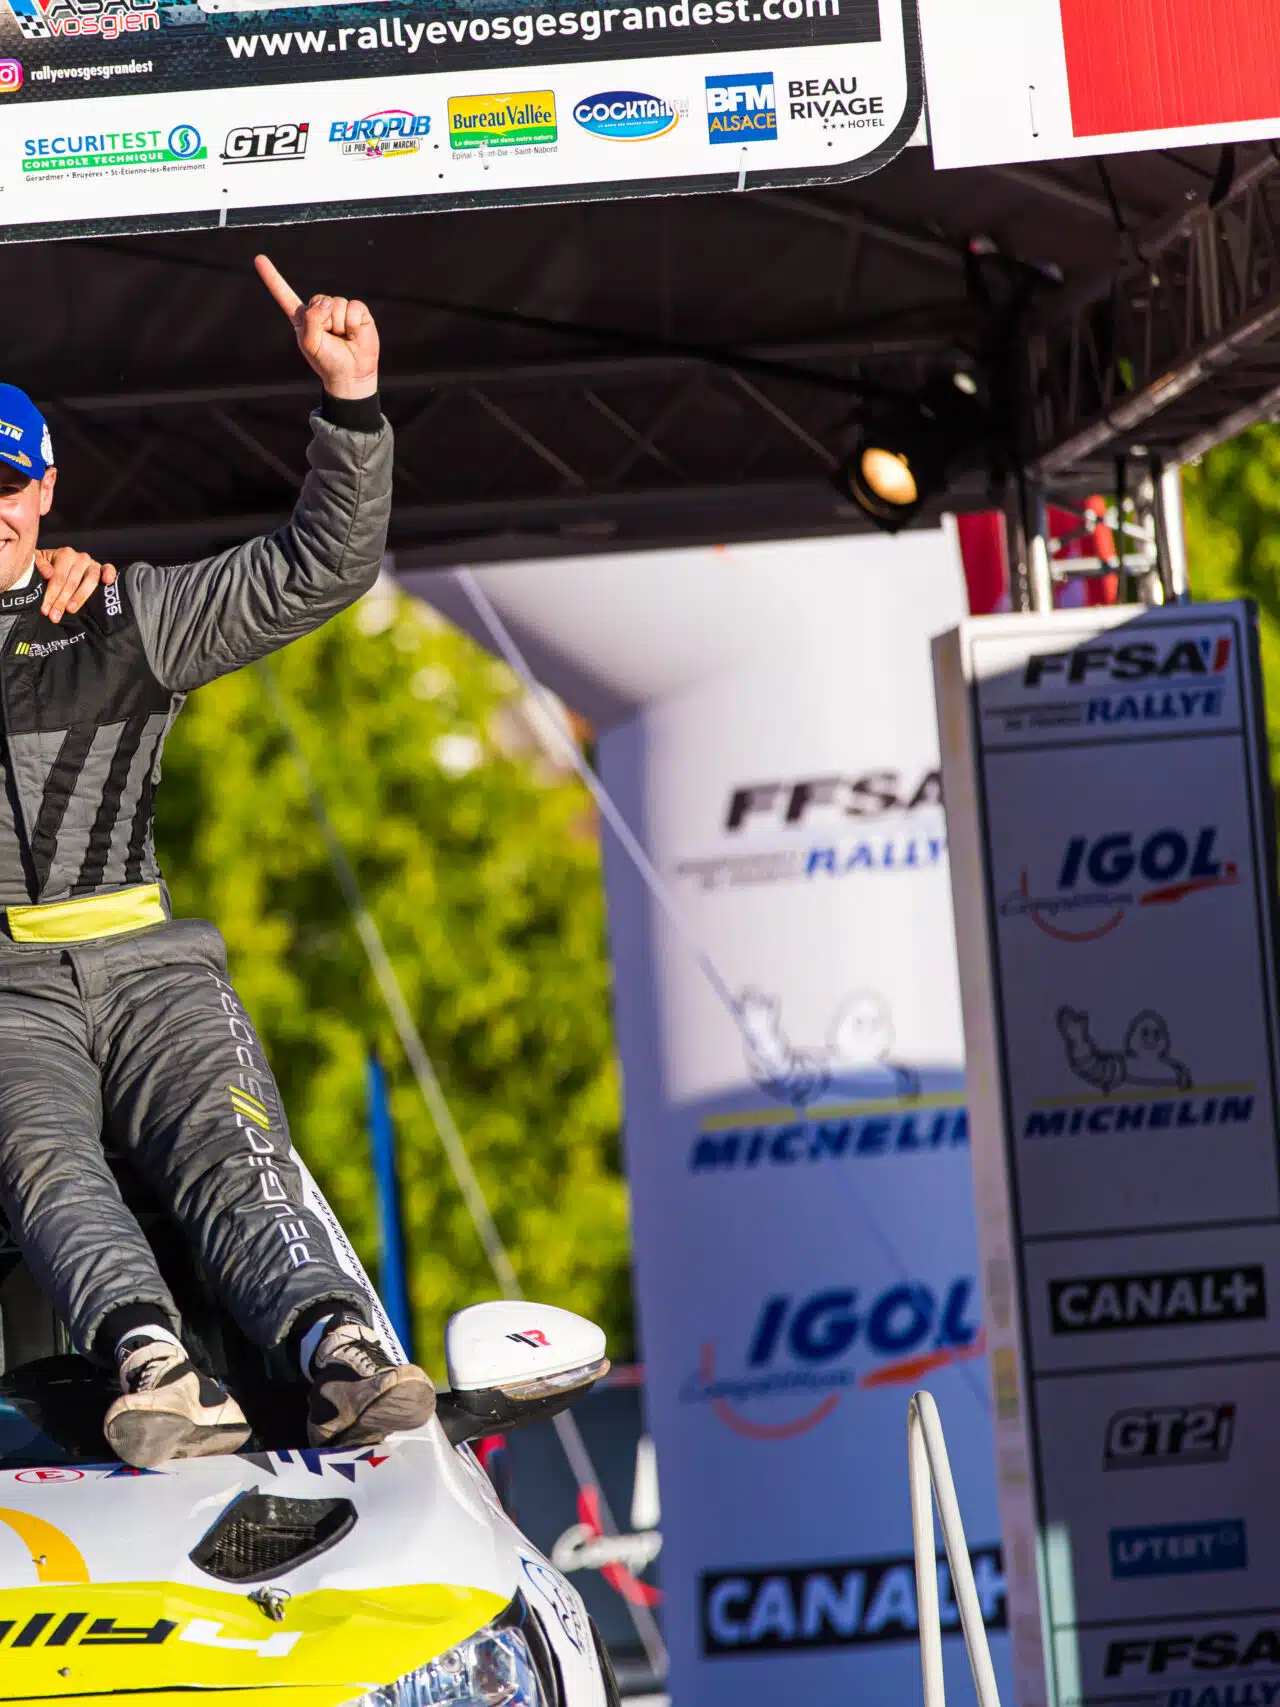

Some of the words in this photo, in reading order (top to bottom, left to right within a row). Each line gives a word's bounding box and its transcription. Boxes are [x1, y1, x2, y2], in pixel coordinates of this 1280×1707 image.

[49, 11, 159, 38] vosgien
[226, 0, 840, 58] www.rallyevosgesgrandest.com
[30, 60, 153, 82] rallyevosgesgrandest
[707, 84, 774, 113] BFM
[788, 77, 857, 98] BEAU
[789, 96, 884, 119] RIVAGE
[329, 115, 431, 142] EUROPUB
[709, 112, 776, 133] ALSACE
[847, 119, 885, 129] HOTEL
[24, 131, 162, 156] SECURITEST
[24, 159, 89, 170] CONTROLE
[93, 152, 164, 165] TECHNIQUE
[1023, 640, 1207, 688] FFSA
[1023, 1095, 1255, 1139] MICHELIN
[1058, 1271, 1258, 1326] CANAL+
